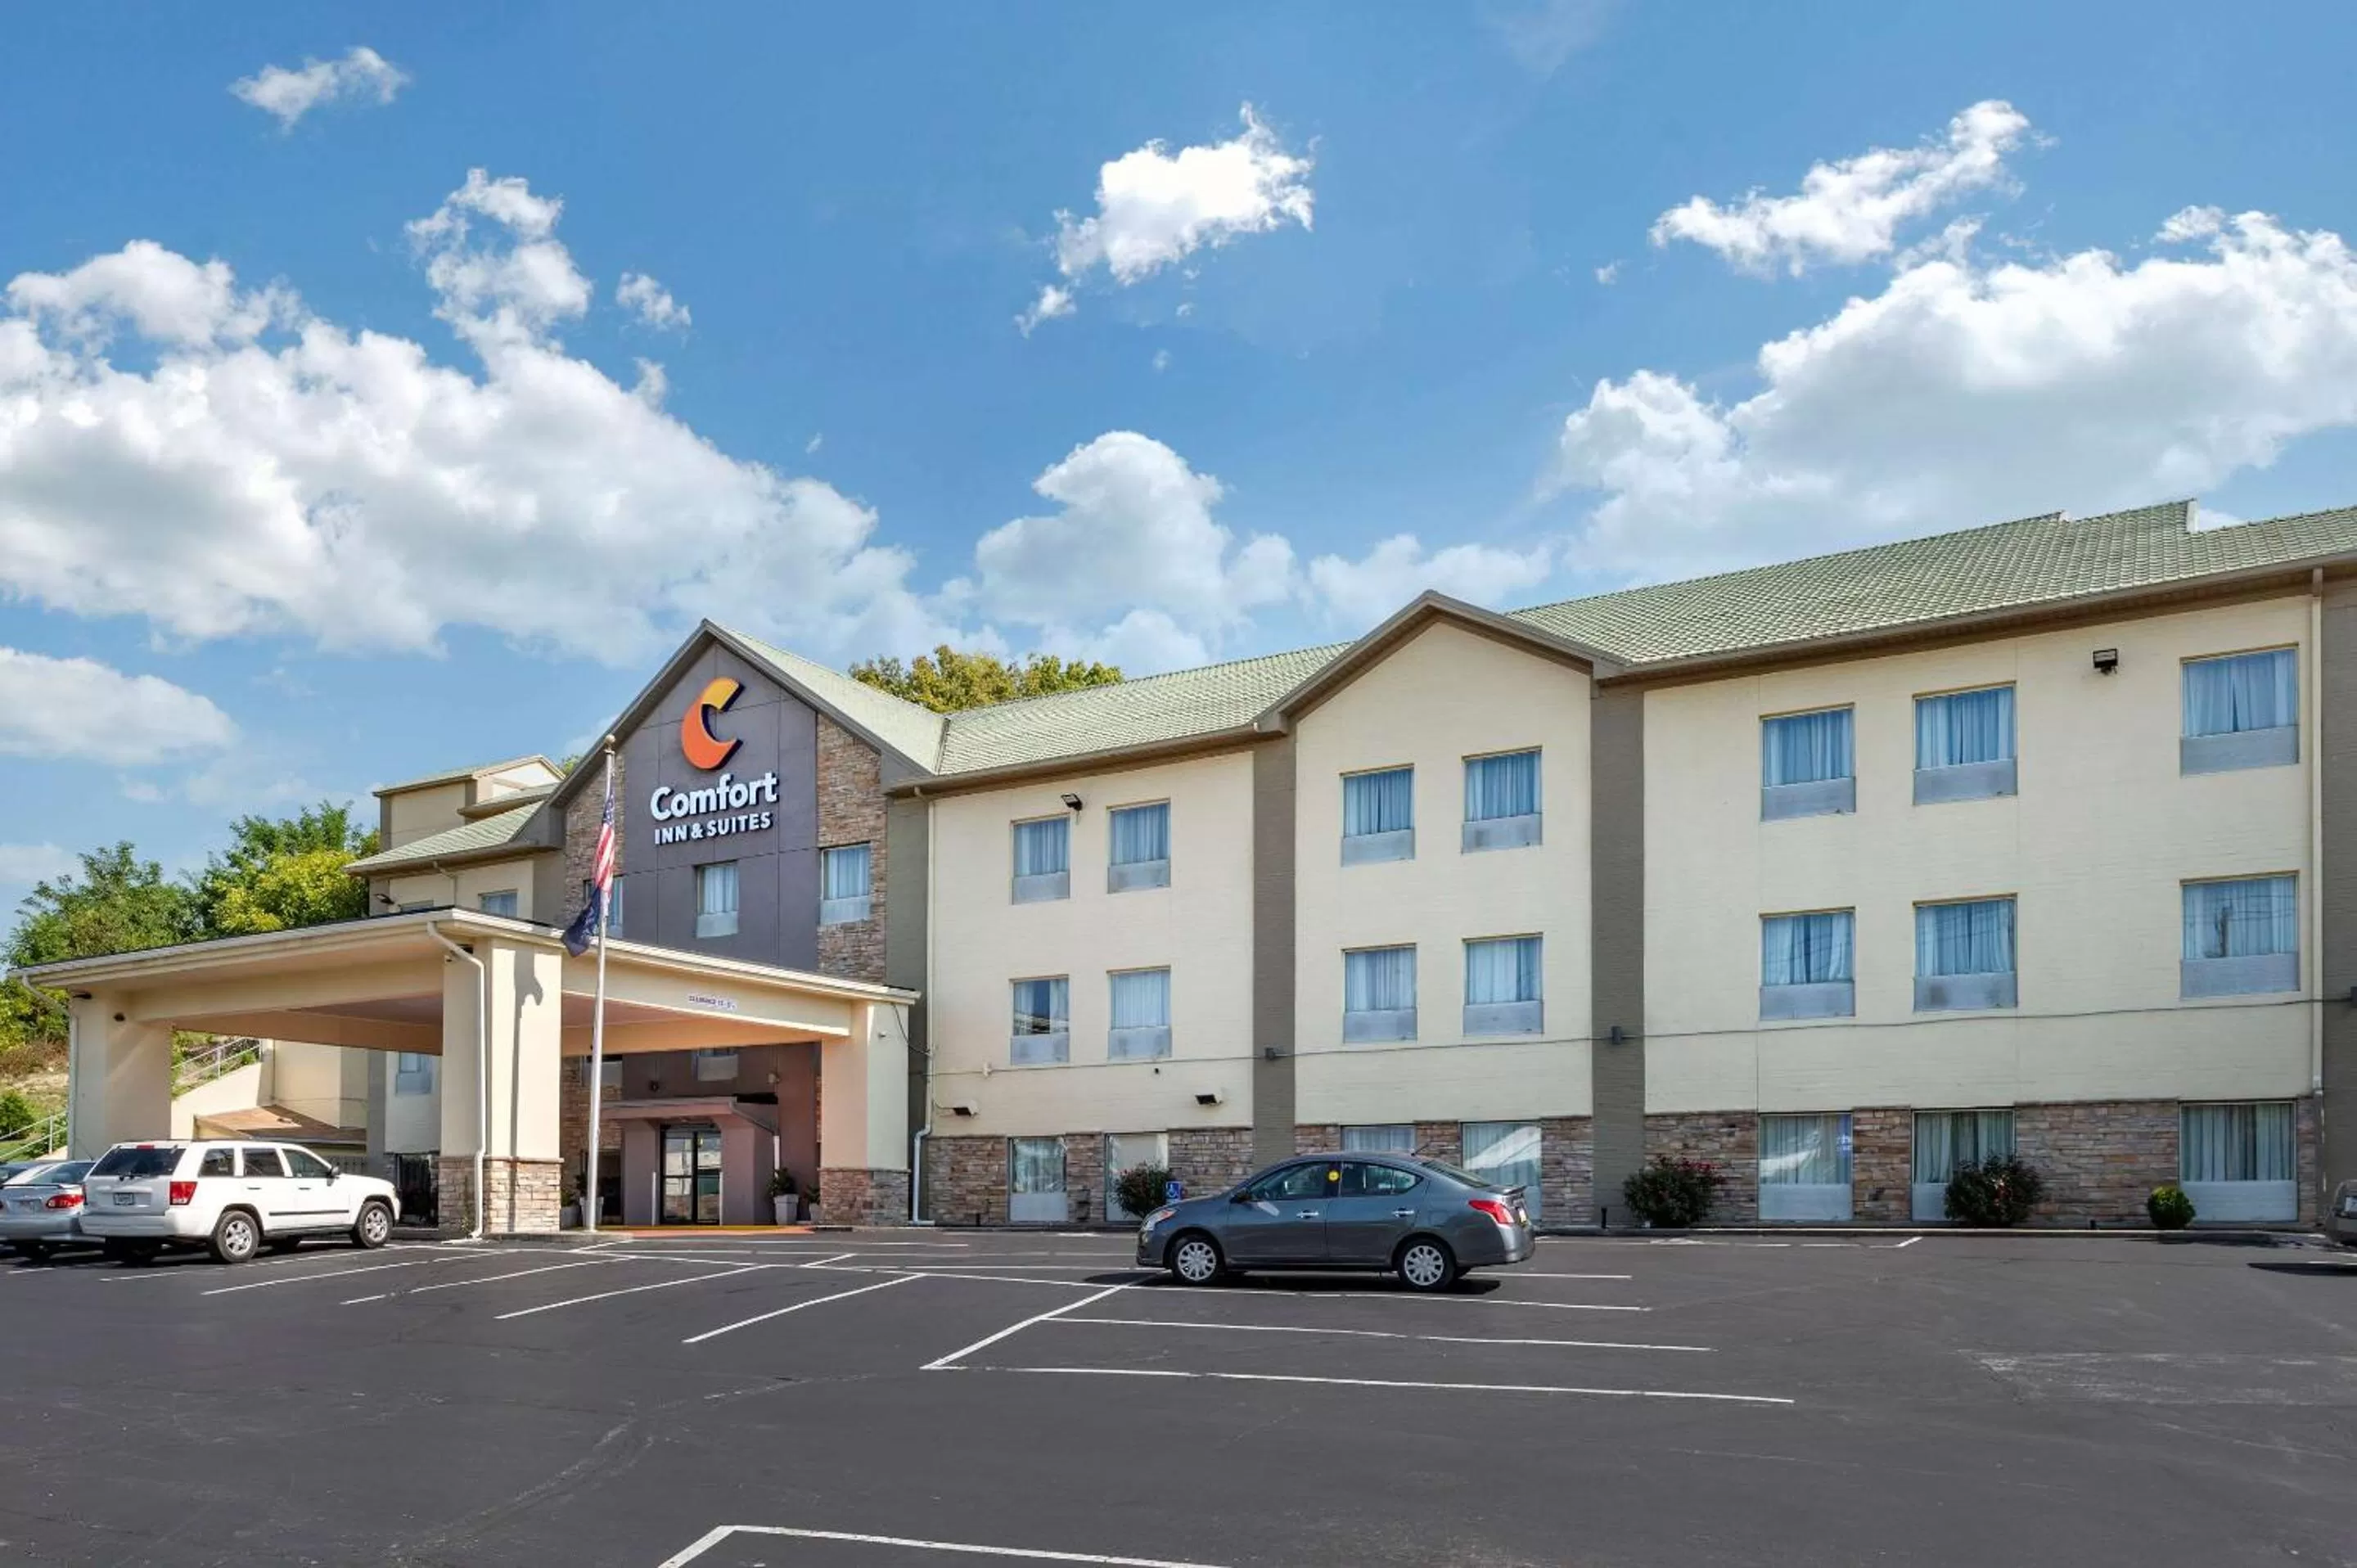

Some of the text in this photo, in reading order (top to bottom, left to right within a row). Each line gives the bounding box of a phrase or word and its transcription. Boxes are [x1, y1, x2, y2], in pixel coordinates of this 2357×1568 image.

[650, 773, 777, 821] Comfort
[655, 812, 771, 845] INN & SUITES
